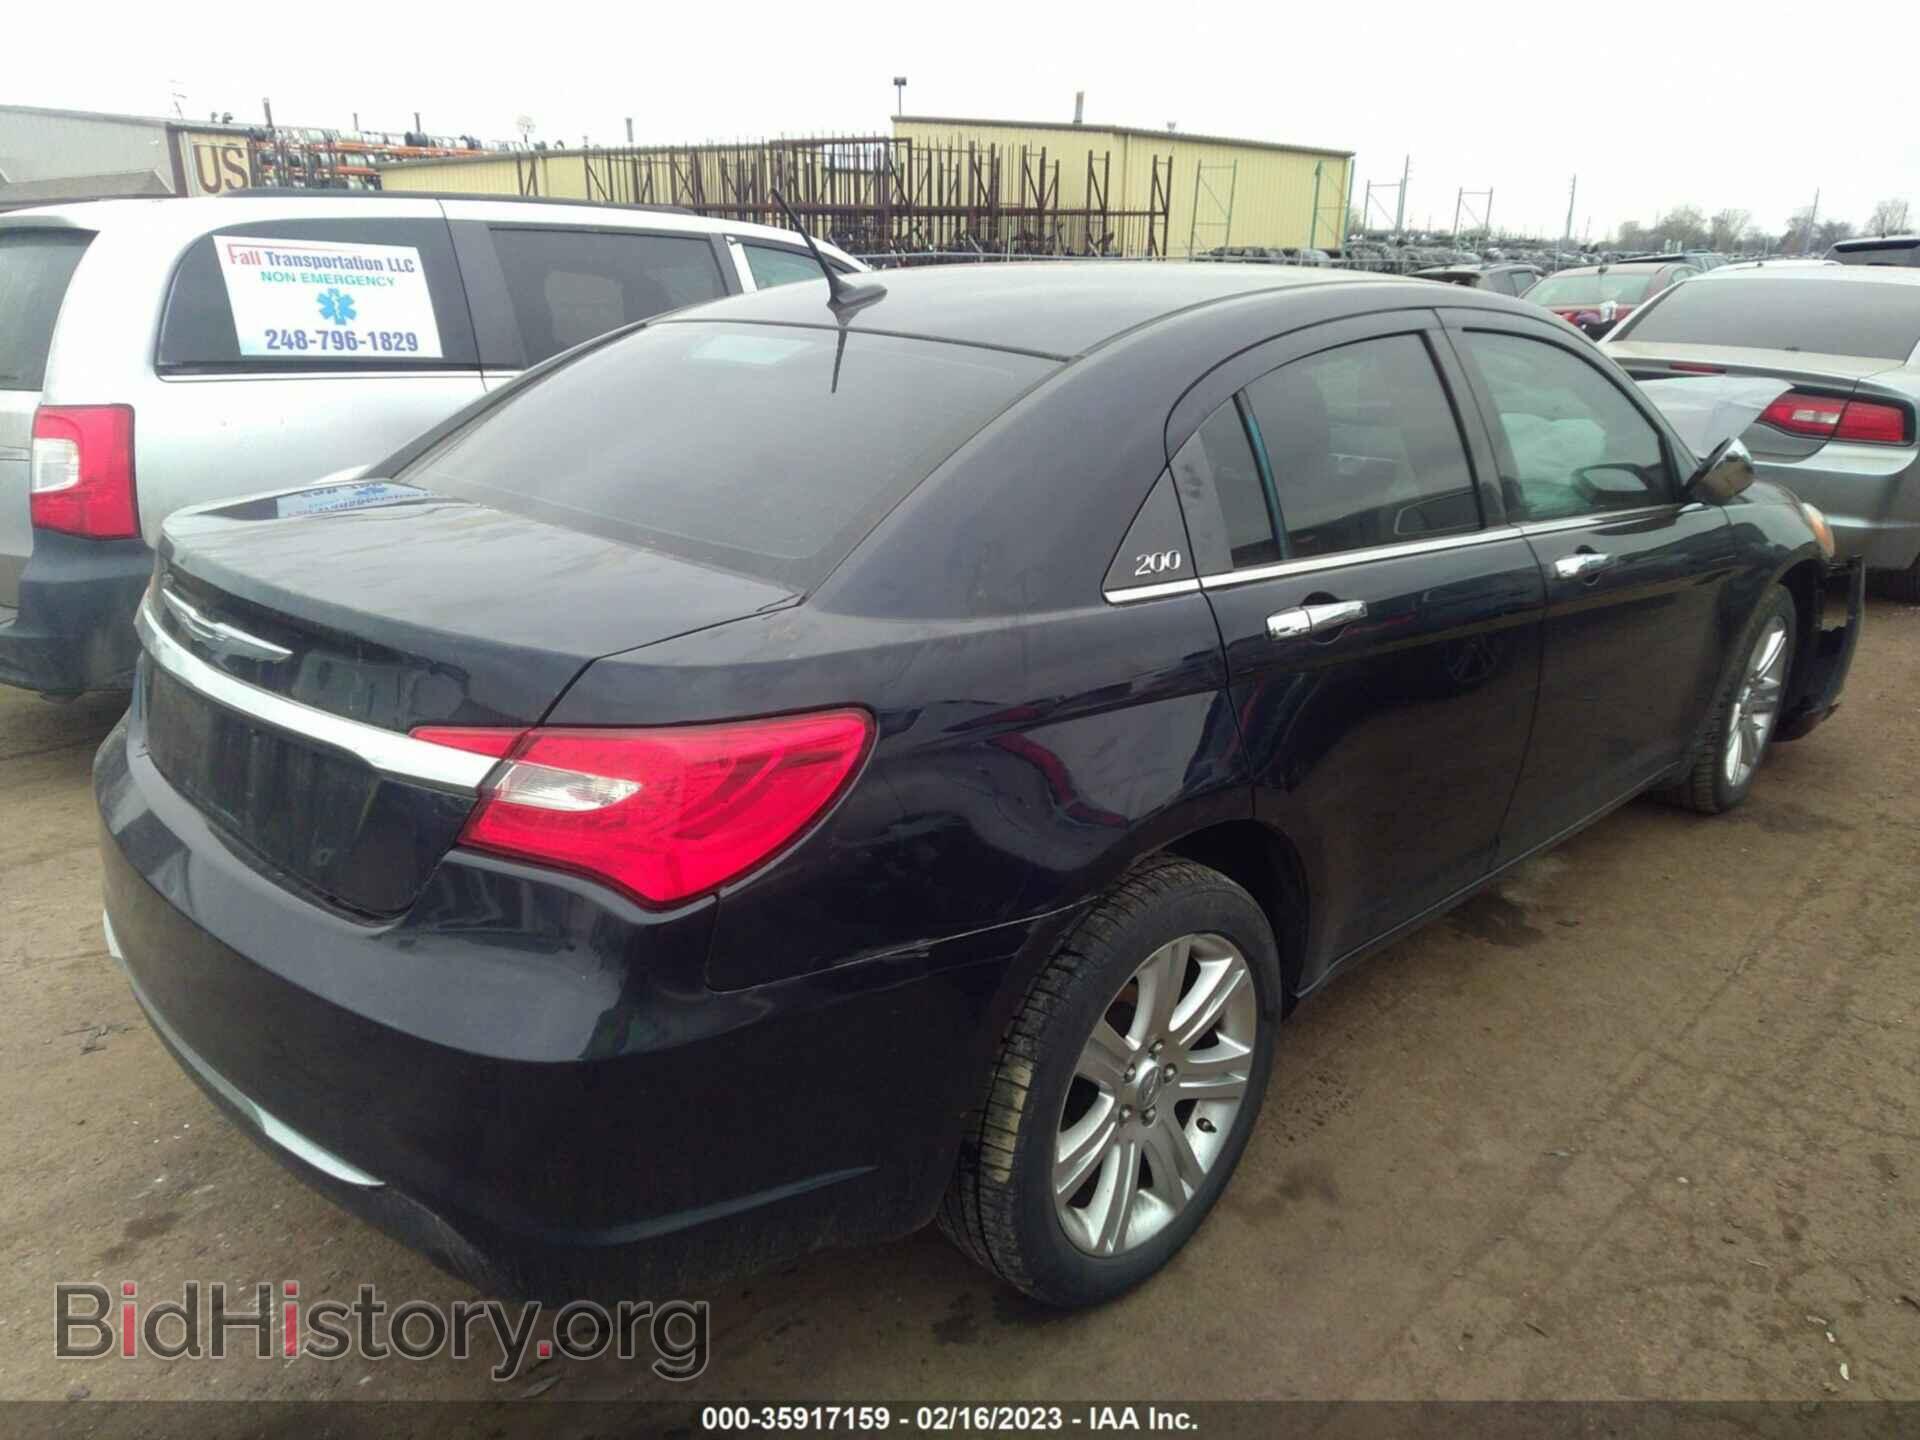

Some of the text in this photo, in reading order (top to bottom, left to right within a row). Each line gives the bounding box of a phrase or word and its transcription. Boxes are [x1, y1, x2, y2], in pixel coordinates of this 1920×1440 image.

[264, 250, 384, 271] Transportation
[387, 257, 415, 273] LLC
[261, 271, 396, 287] NON EMERGENCY
[264, 328, 419, 352] 248-796-1829
[1135, 549, 1181, 576] 200
